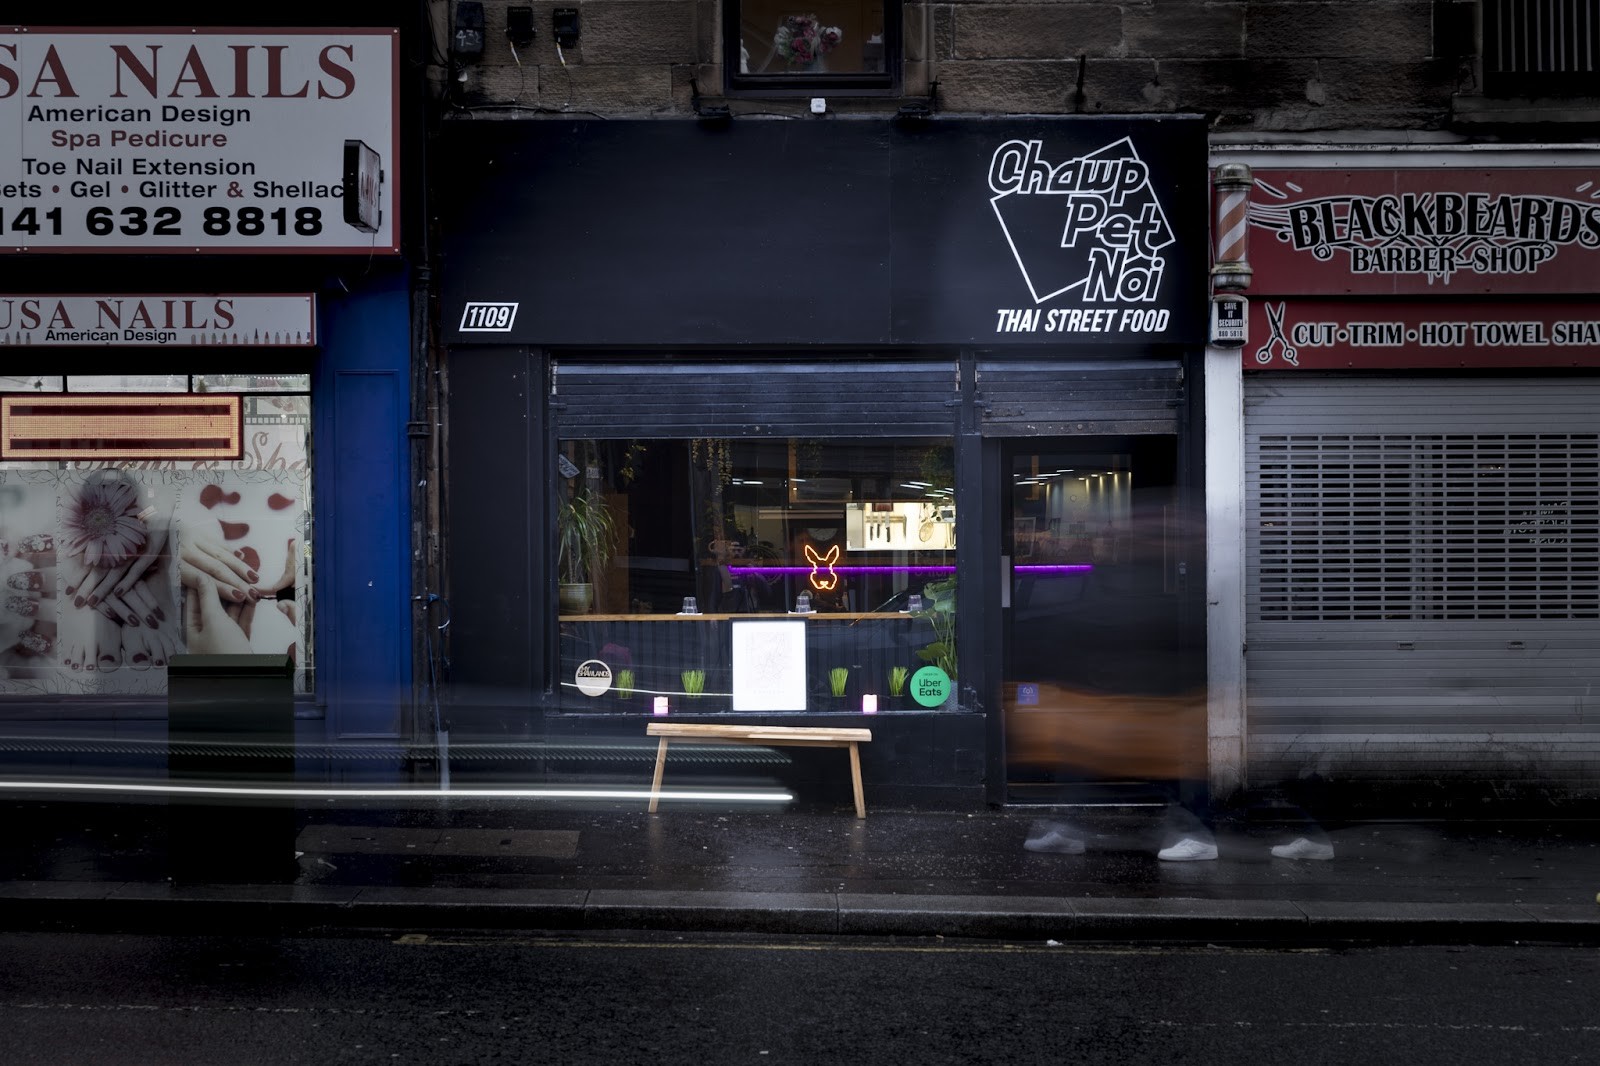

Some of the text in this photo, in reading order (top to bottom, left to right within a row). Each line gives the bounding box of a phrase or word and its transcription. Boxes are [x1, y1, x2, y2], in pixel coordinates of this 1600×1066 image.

[109, 43, 356, 100] NAILS
[27, 105, 251, 126] American Design
[51, 129, 228, 151] Spa Pedicure
[22, 158, 255, 175] Toe Nail Extension
[988, 139, 1150, 207] Chawp
[0, 181, 42, 198] ets
[70, 181, 111, 198] Gel
[139, 181, 217, 198] Glitter
[227, 181, 244, 198] &
[253, 181, 343, 198] Shellac
[0, 206, 323, 236] 41 632 8818
[1061, 193, 1161, 260] Pet
[1352, 247, 1545, 273] BARBER SHOP
[1083, 247, 1165, 302] Noi
[95, 299, 235, 329] NAILS
[469, 306, 510, 328] 1109
[996, 308, 1171, 332] THAI STREET FOOD
[1218, 319, 1243, 327] SECURITY
[45, 329, 177, 344] American Design
[1471, 322, 1550, 346] TOWEL
[1552, 321, 1600, 346] SHA
[918, 678, 942, 688] Uber
[918, 687, 942, 697] Eats
